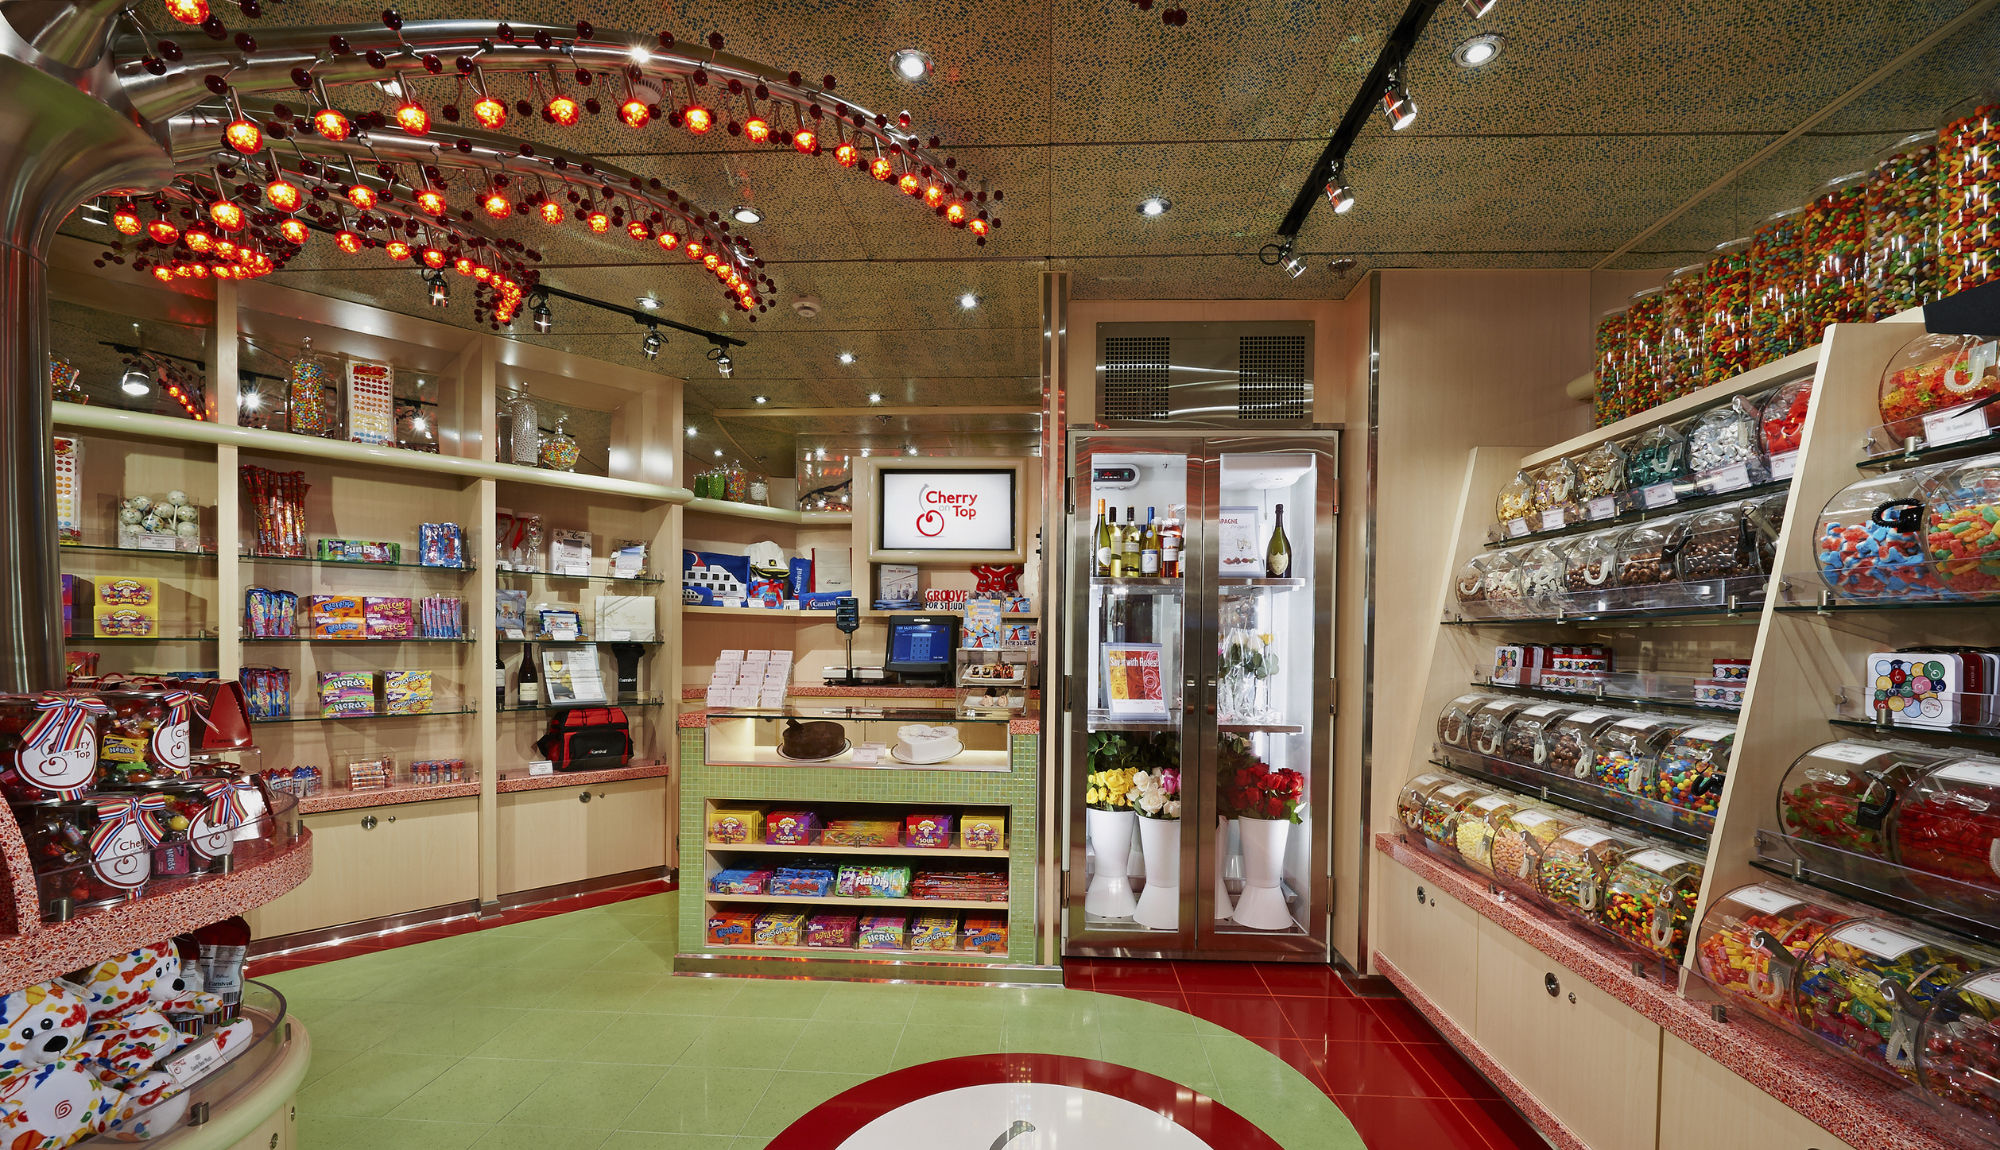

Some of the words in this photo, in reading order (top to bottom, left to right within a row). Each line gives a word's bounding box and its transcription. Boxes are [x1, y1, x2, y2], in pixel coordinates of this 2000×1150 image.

[926, 490, 977, 506] Cherry
[952, 505, 976, 520] Top
[344, 545, 362, 555] Fun
[926, 590, 968, 602] GROOVE
[812, 600, 836, 608] Carniva
[1110, 656, 1120, 668] Say
[1127, 657, 1138, 666] with
[74, 751, 90, 759] Top
[855, 876, 872, 887] Fun
[873, 876, 889, 890] Dip
